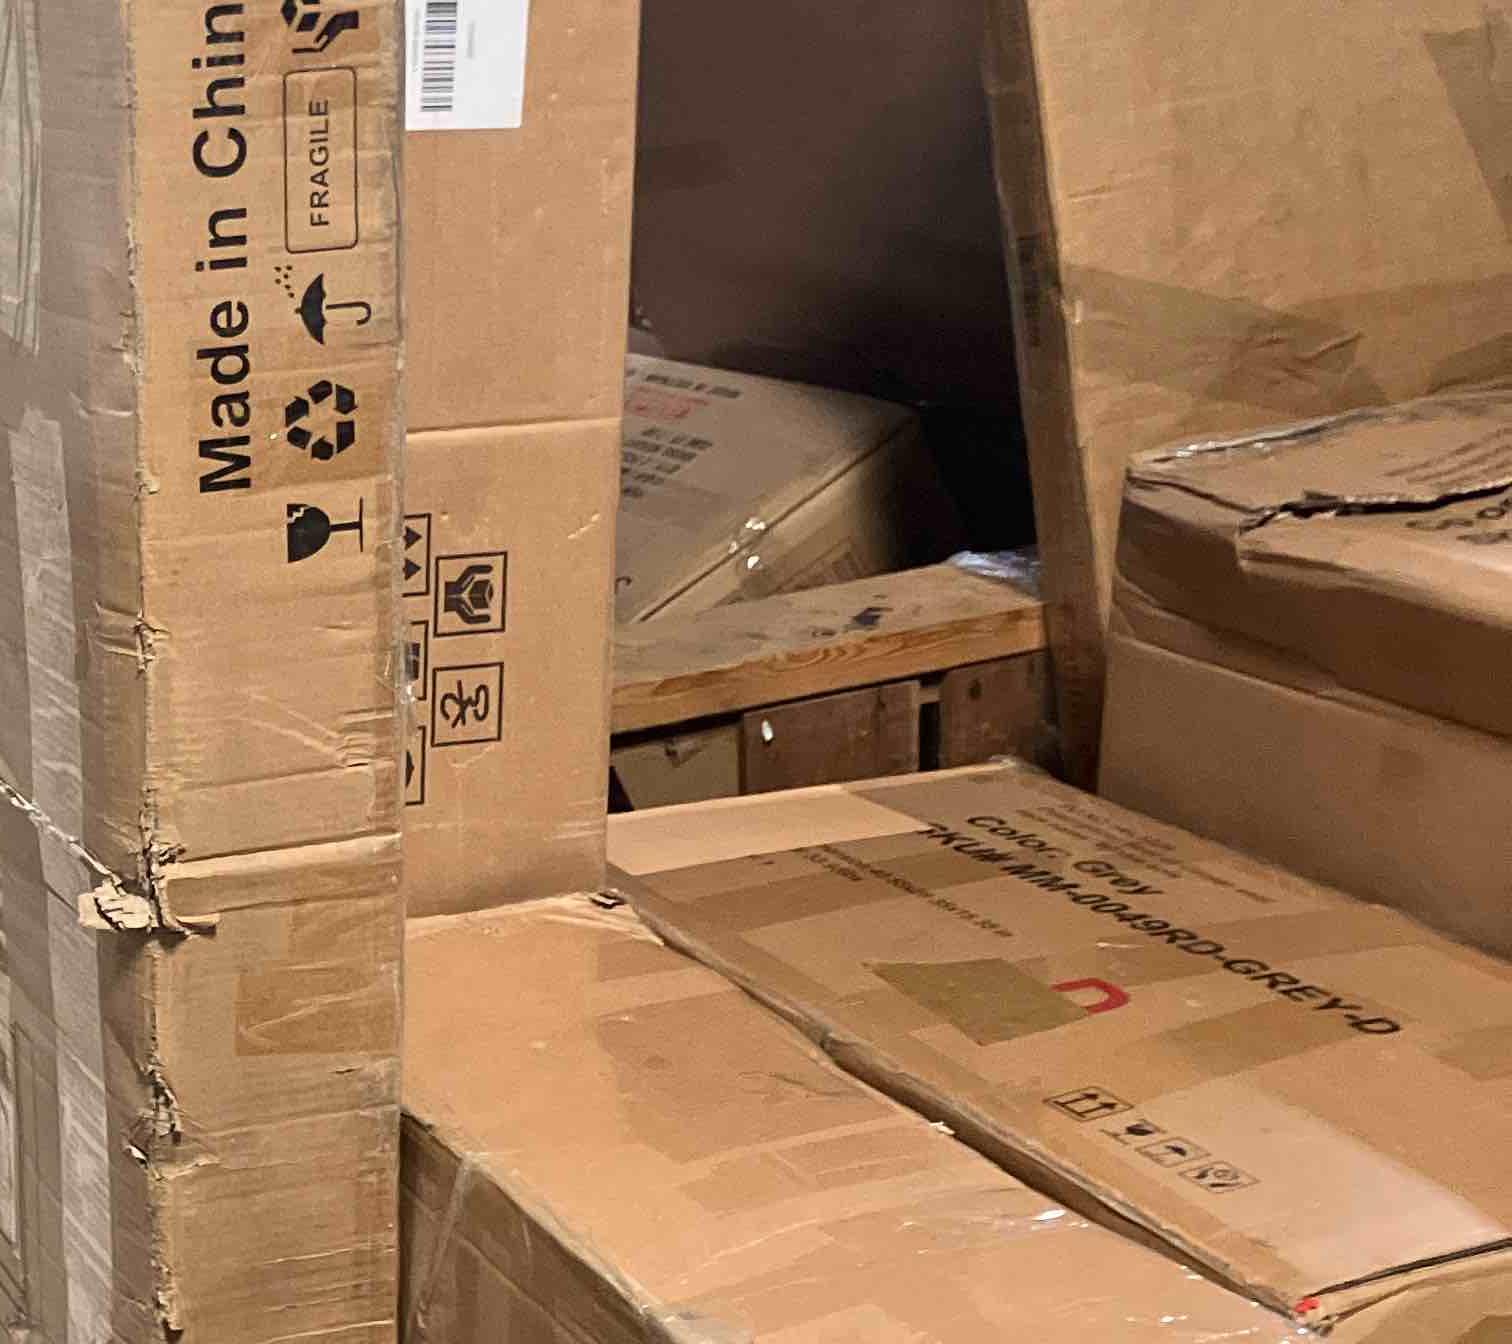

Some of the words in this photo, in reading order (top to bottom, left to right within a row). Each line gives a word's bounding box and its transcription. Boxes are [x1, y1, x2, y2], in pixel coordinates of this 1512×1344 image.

[309, 97, 330, 227] FRAGILE
[195, 207, 249, 271] in
[197, 299, 251, 494] Made
[965, 815, 1072, 858] Color:
[1072, 859, 1165, 896] Grey
